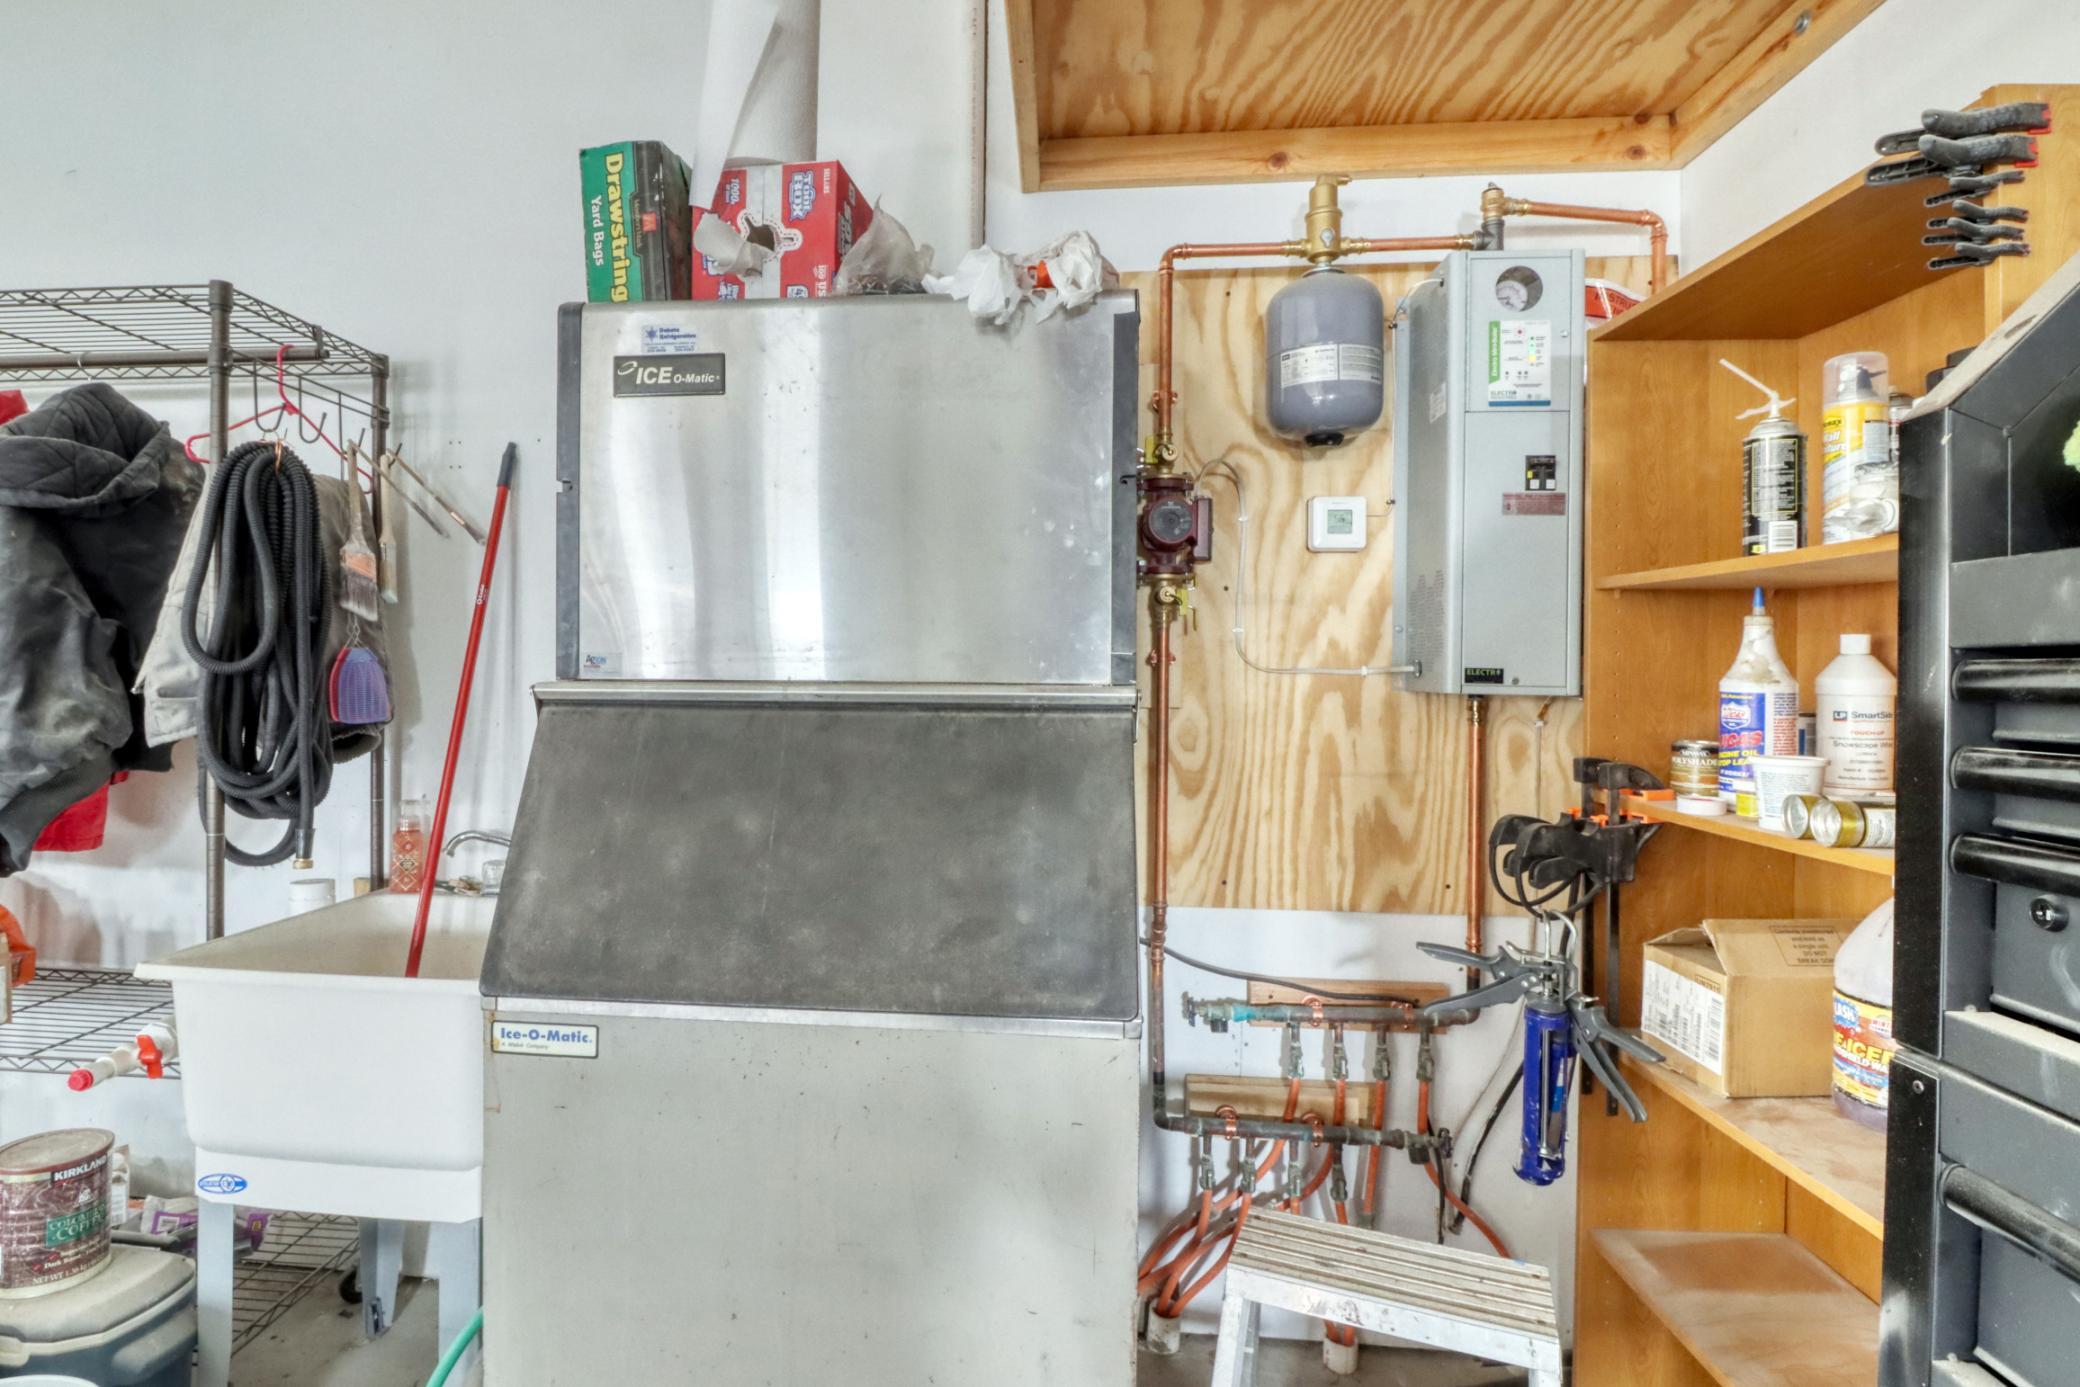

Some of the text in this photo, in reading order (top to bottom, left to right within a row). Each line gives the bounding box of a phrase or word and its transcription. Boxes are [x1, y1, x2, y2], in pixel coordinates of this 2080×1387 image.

[791, 175, 803, 217] BOX
[591, 195, 605, 266] Yard Bags
[605, 152, 630, 303] Drawstring
[635, 366, 673, 385] ICE
